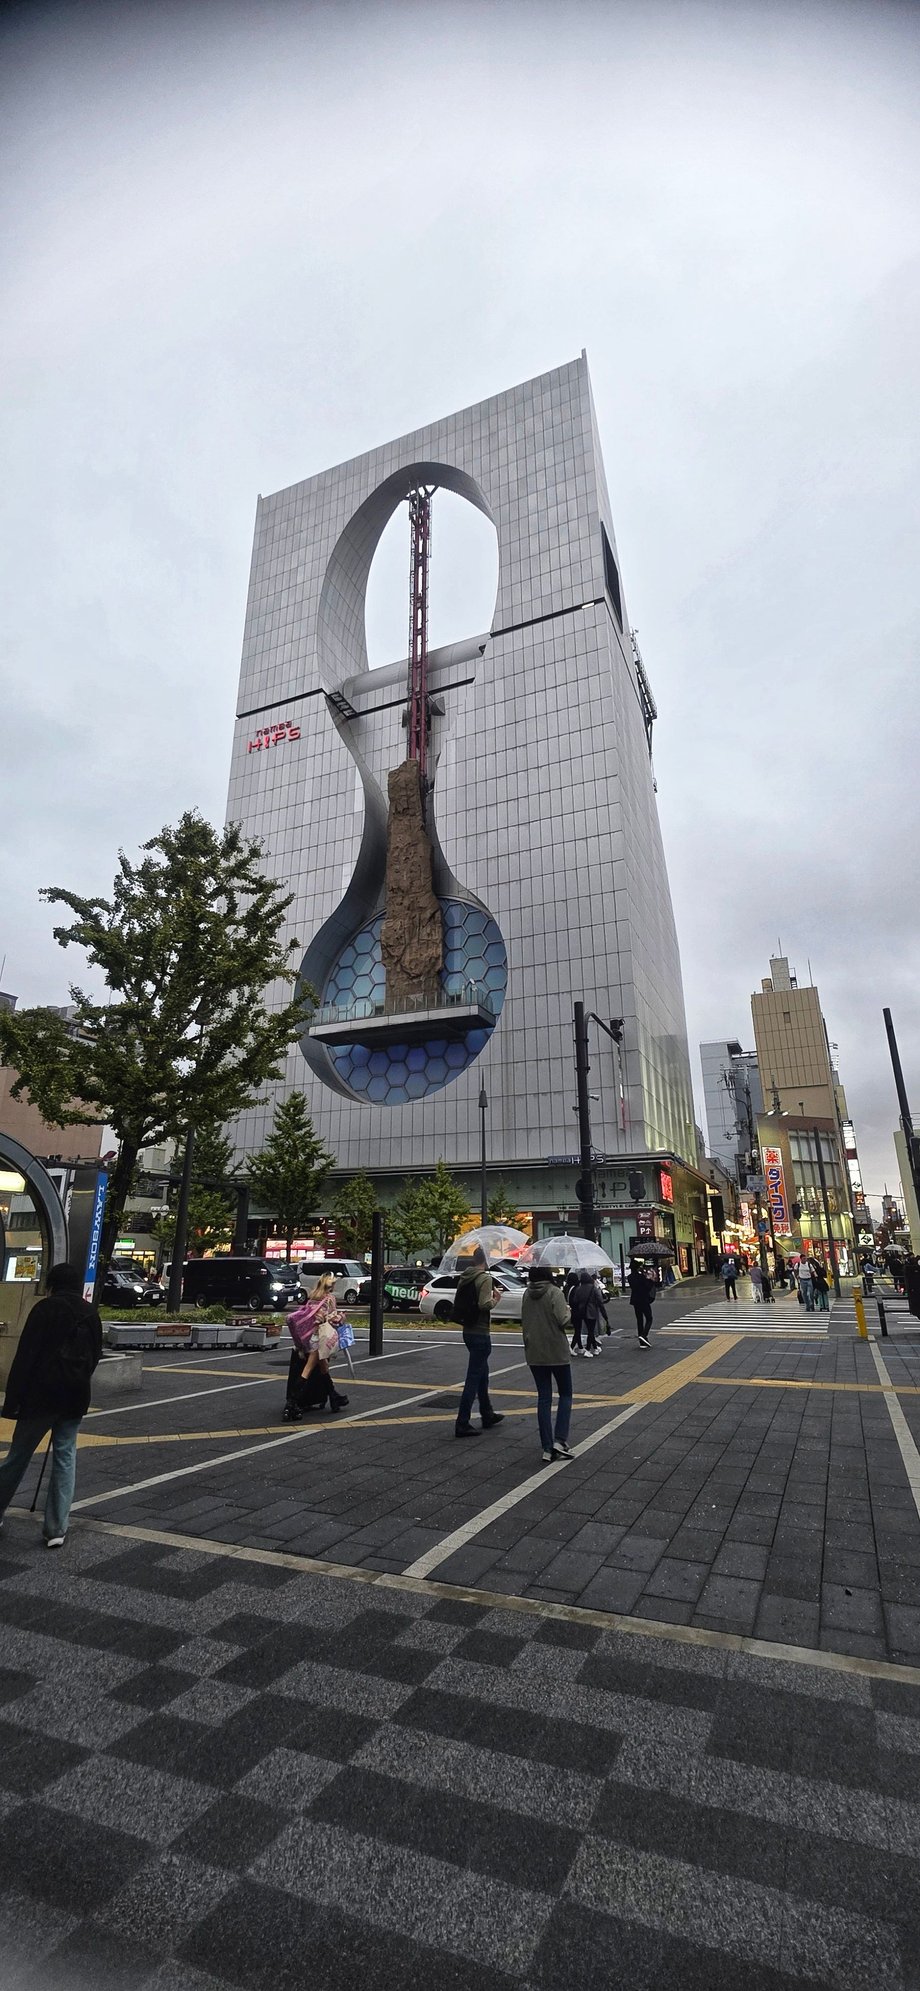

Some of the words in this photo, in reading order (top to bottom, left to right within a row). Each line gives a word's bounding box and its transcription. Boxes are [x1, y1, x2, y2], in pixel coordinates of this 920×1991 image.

[247, 726, 301, 754] HIPS
[571, 1154, 605, 1165] HPS
[766, 1149, 780, 1164] 薬
[768, 1167, 786, 1221] ダイコク
[88, 1184, 105, 1270] LAWSON
[391, 1285, 421, 1300] new
